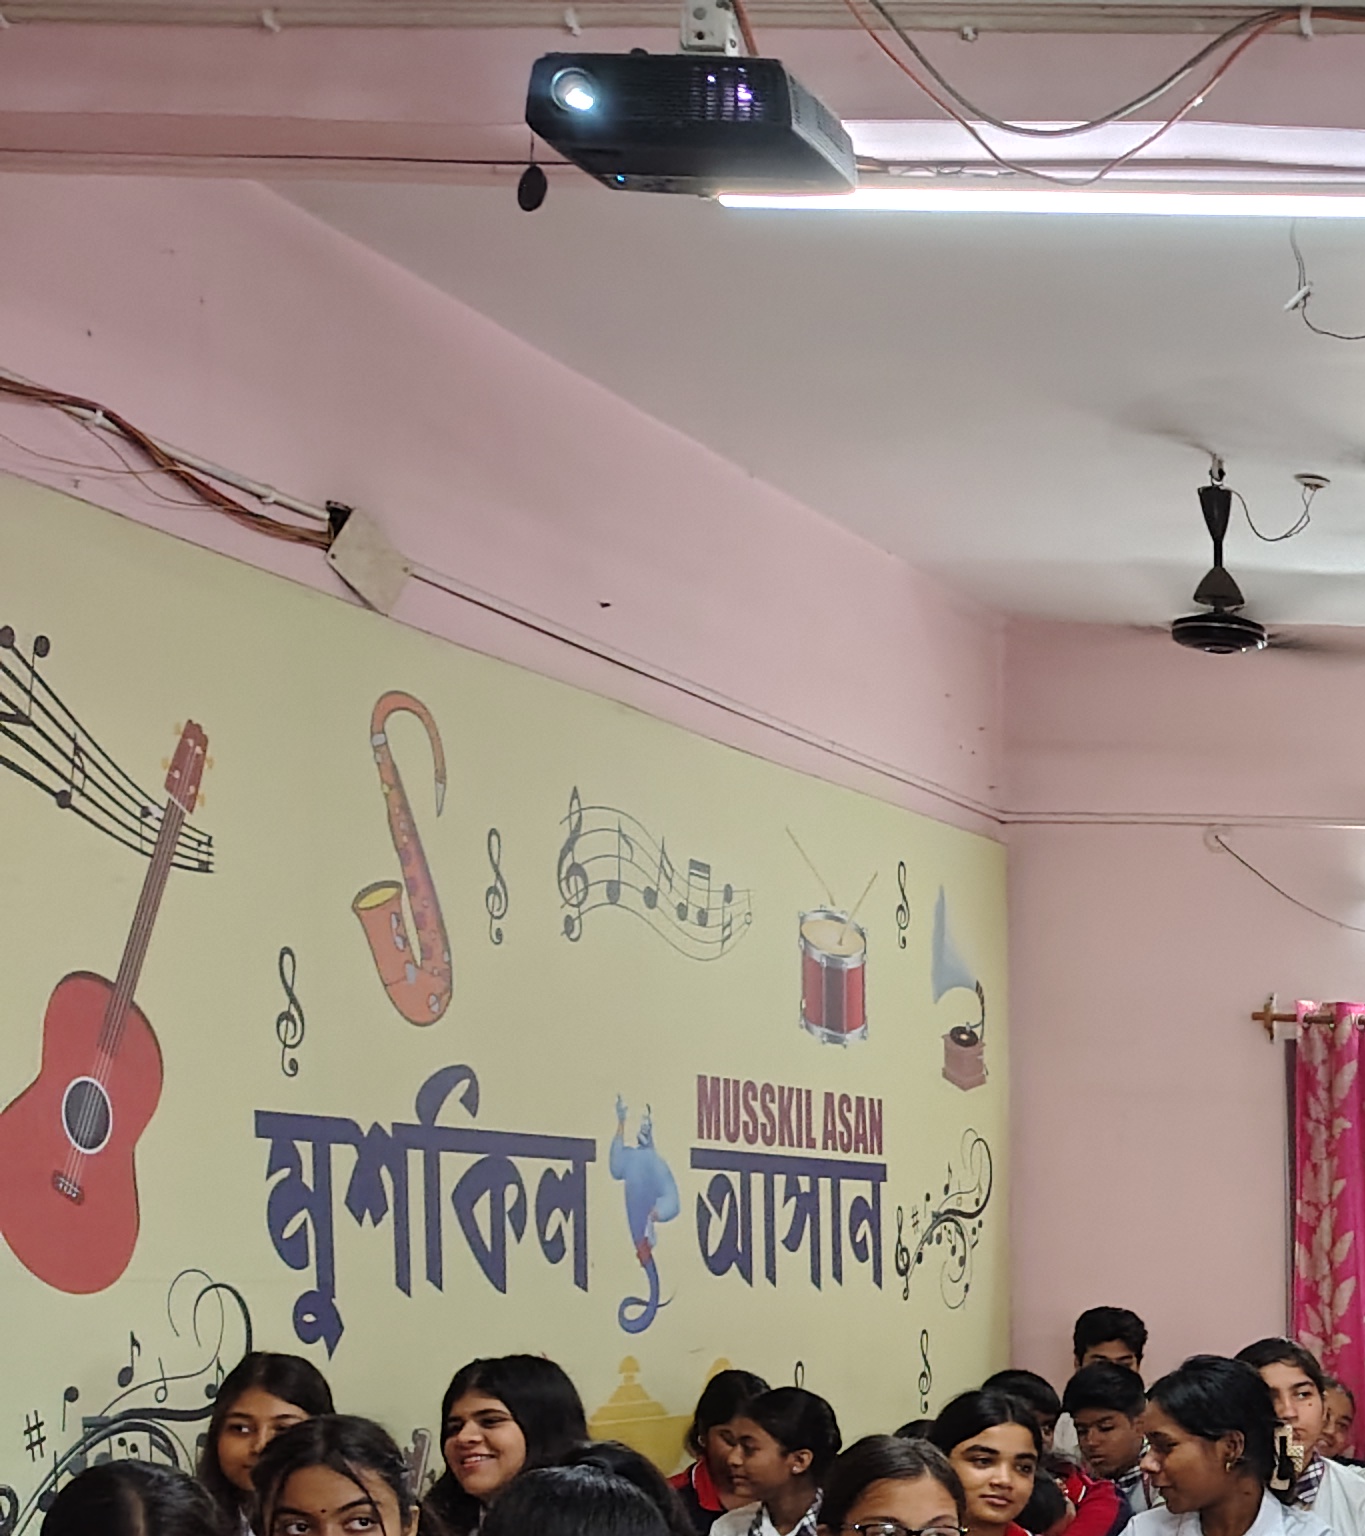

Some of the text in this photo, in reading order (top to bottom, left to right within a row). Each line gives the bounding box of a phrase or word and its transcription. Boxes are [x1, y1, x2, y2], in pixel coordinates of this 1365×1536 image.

[697, 1074, 883, 1155] MUSSKIL ASAN
[254, 1064, 887, 1361] মুশকিল আসান
